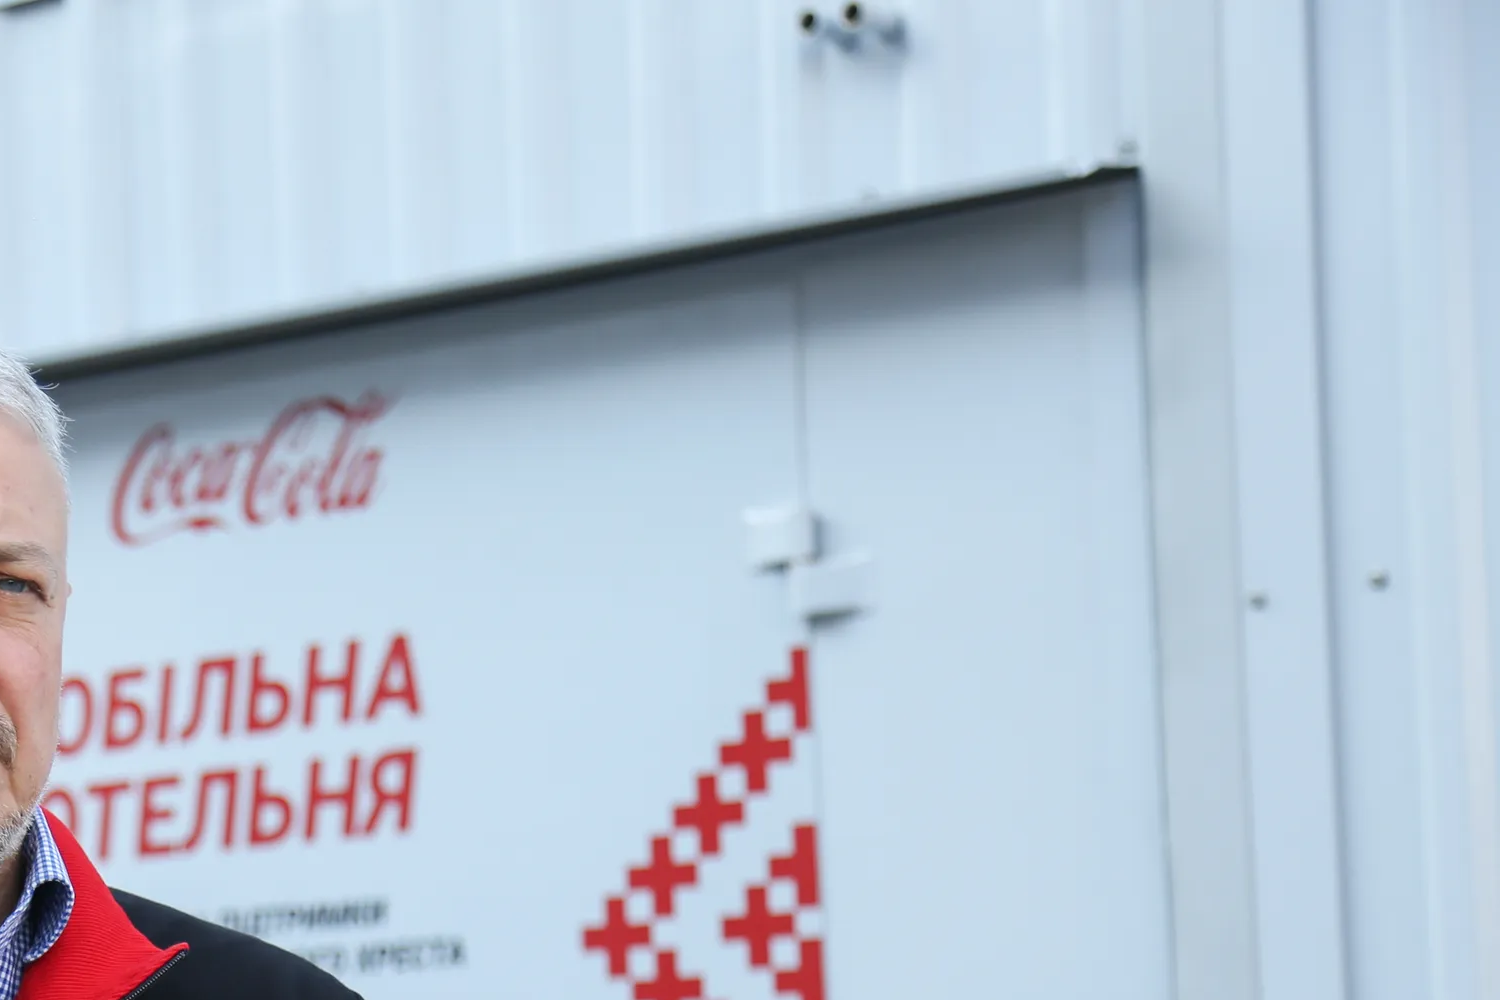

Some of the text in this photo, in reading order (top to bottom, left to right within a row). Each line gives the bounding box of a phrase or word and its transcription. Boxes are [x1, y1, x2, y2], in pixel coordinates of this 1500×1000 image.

[112, 388, 396, 545] Coca-Cola
[56, 633, 421, 757] ОБІЛЬНА
[42, 748, 419, 863] ТЕЛЬНЯ
